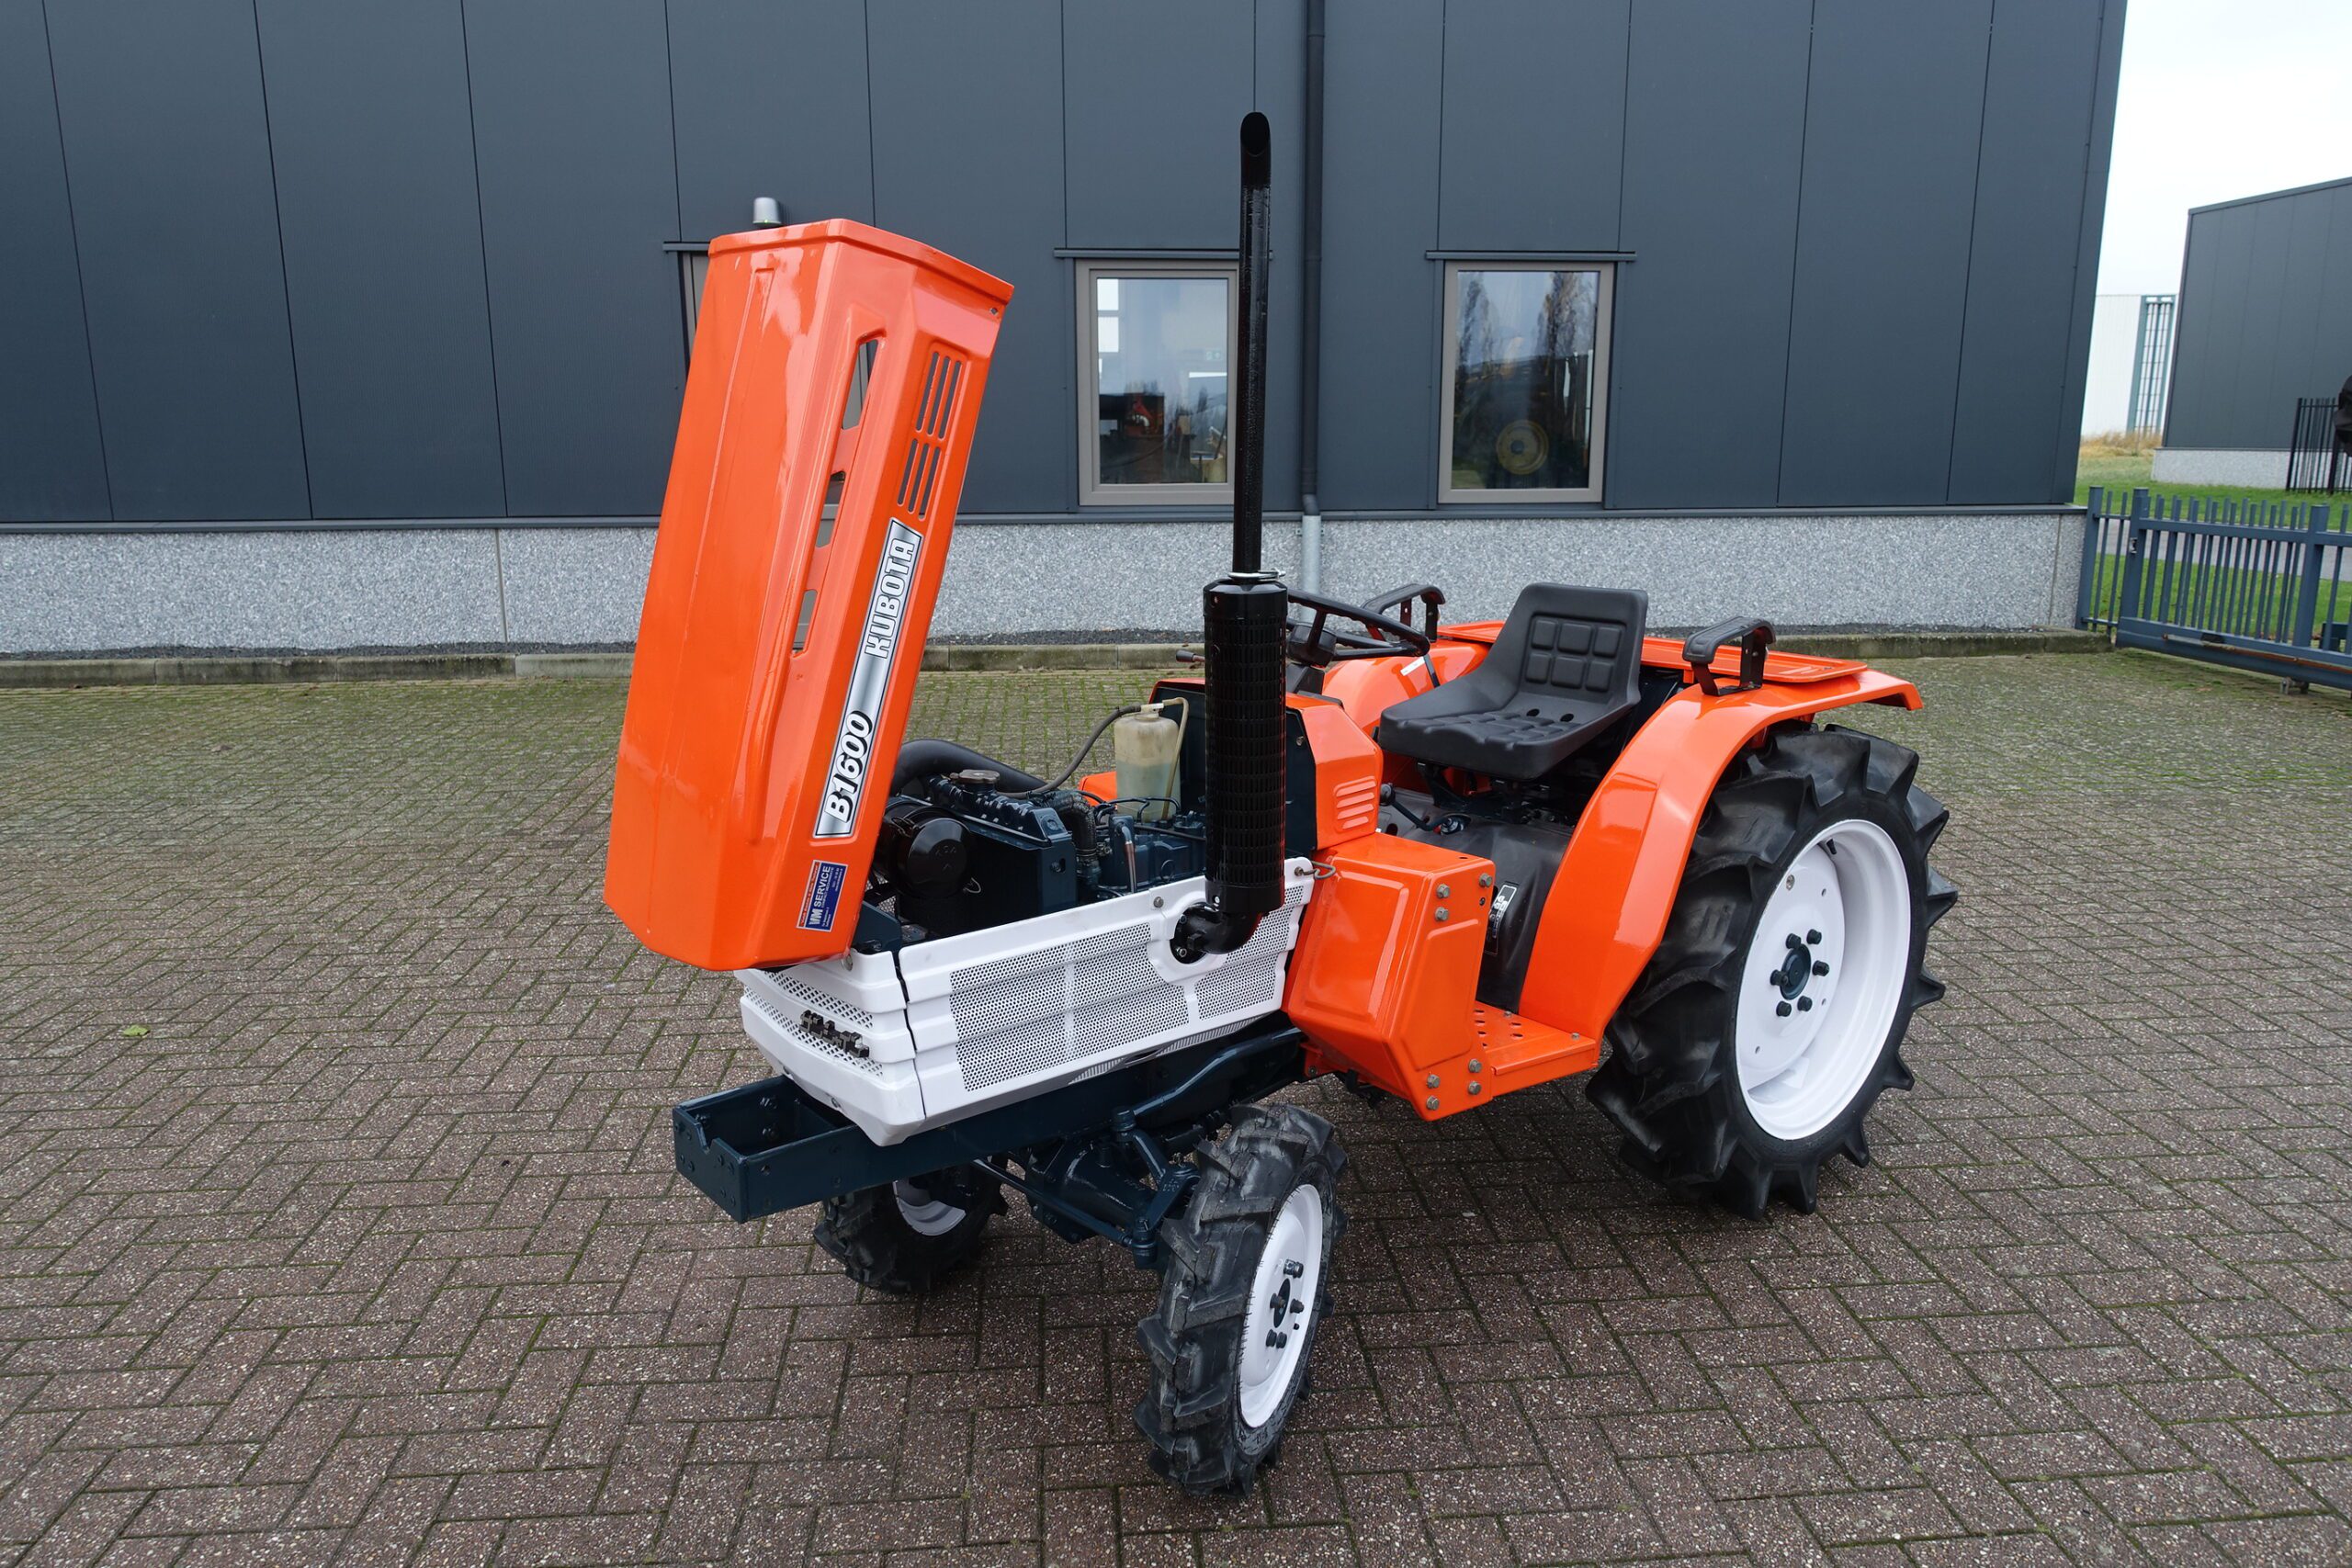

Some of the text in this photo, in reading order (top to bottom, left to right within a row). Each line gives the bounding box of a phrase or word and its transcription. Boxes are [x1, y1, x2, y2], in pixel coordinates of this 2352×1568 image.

[824, 537, 915, 823] B1600 KUBOTA
[813, 866, 831, 908] SERVICE
